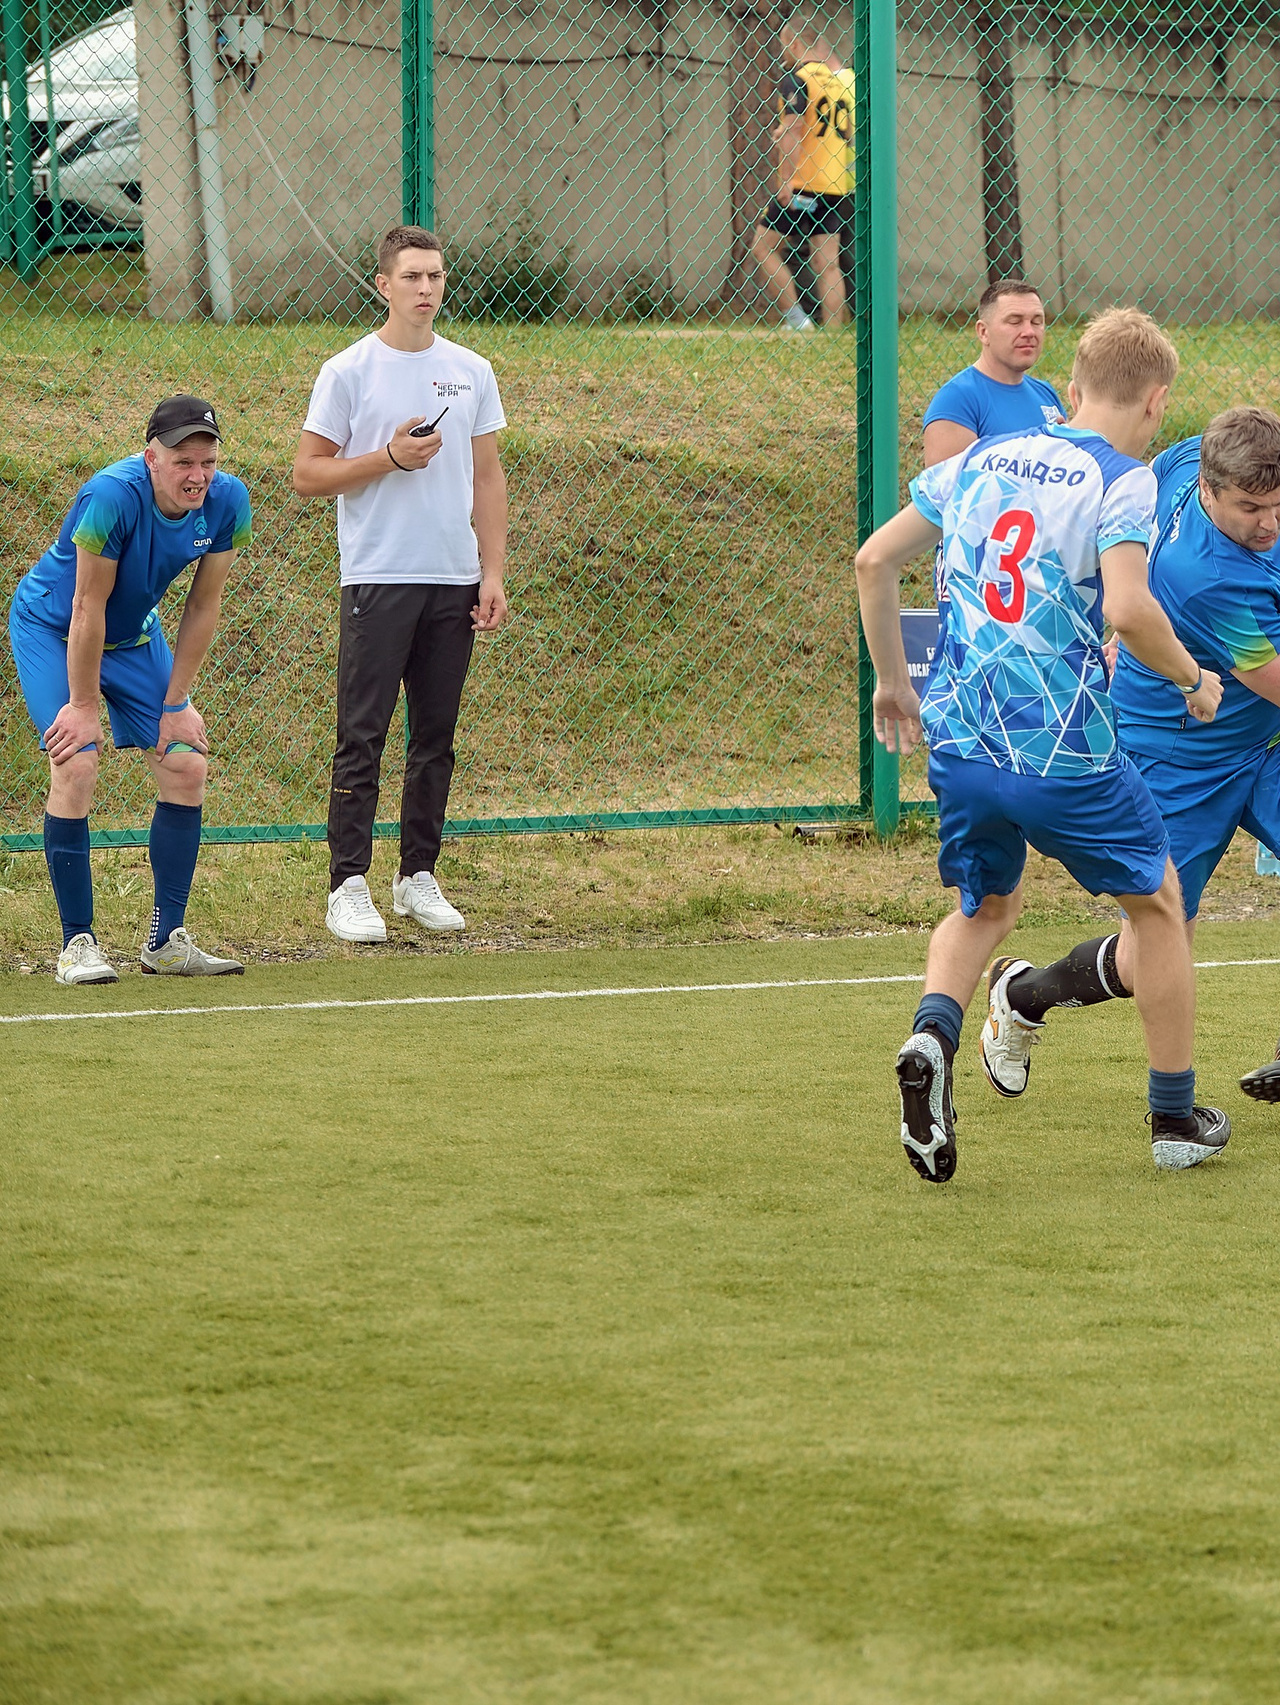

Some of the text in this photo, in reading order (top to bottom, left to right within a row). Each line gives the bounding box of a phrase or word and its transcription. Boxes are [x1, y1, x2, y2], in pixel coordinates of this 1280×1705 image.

[815, 95, 852, 143] 90
[981, 453, 1086, 487] КРАЙДЭО
[984, 509, 1036, 624] 3
